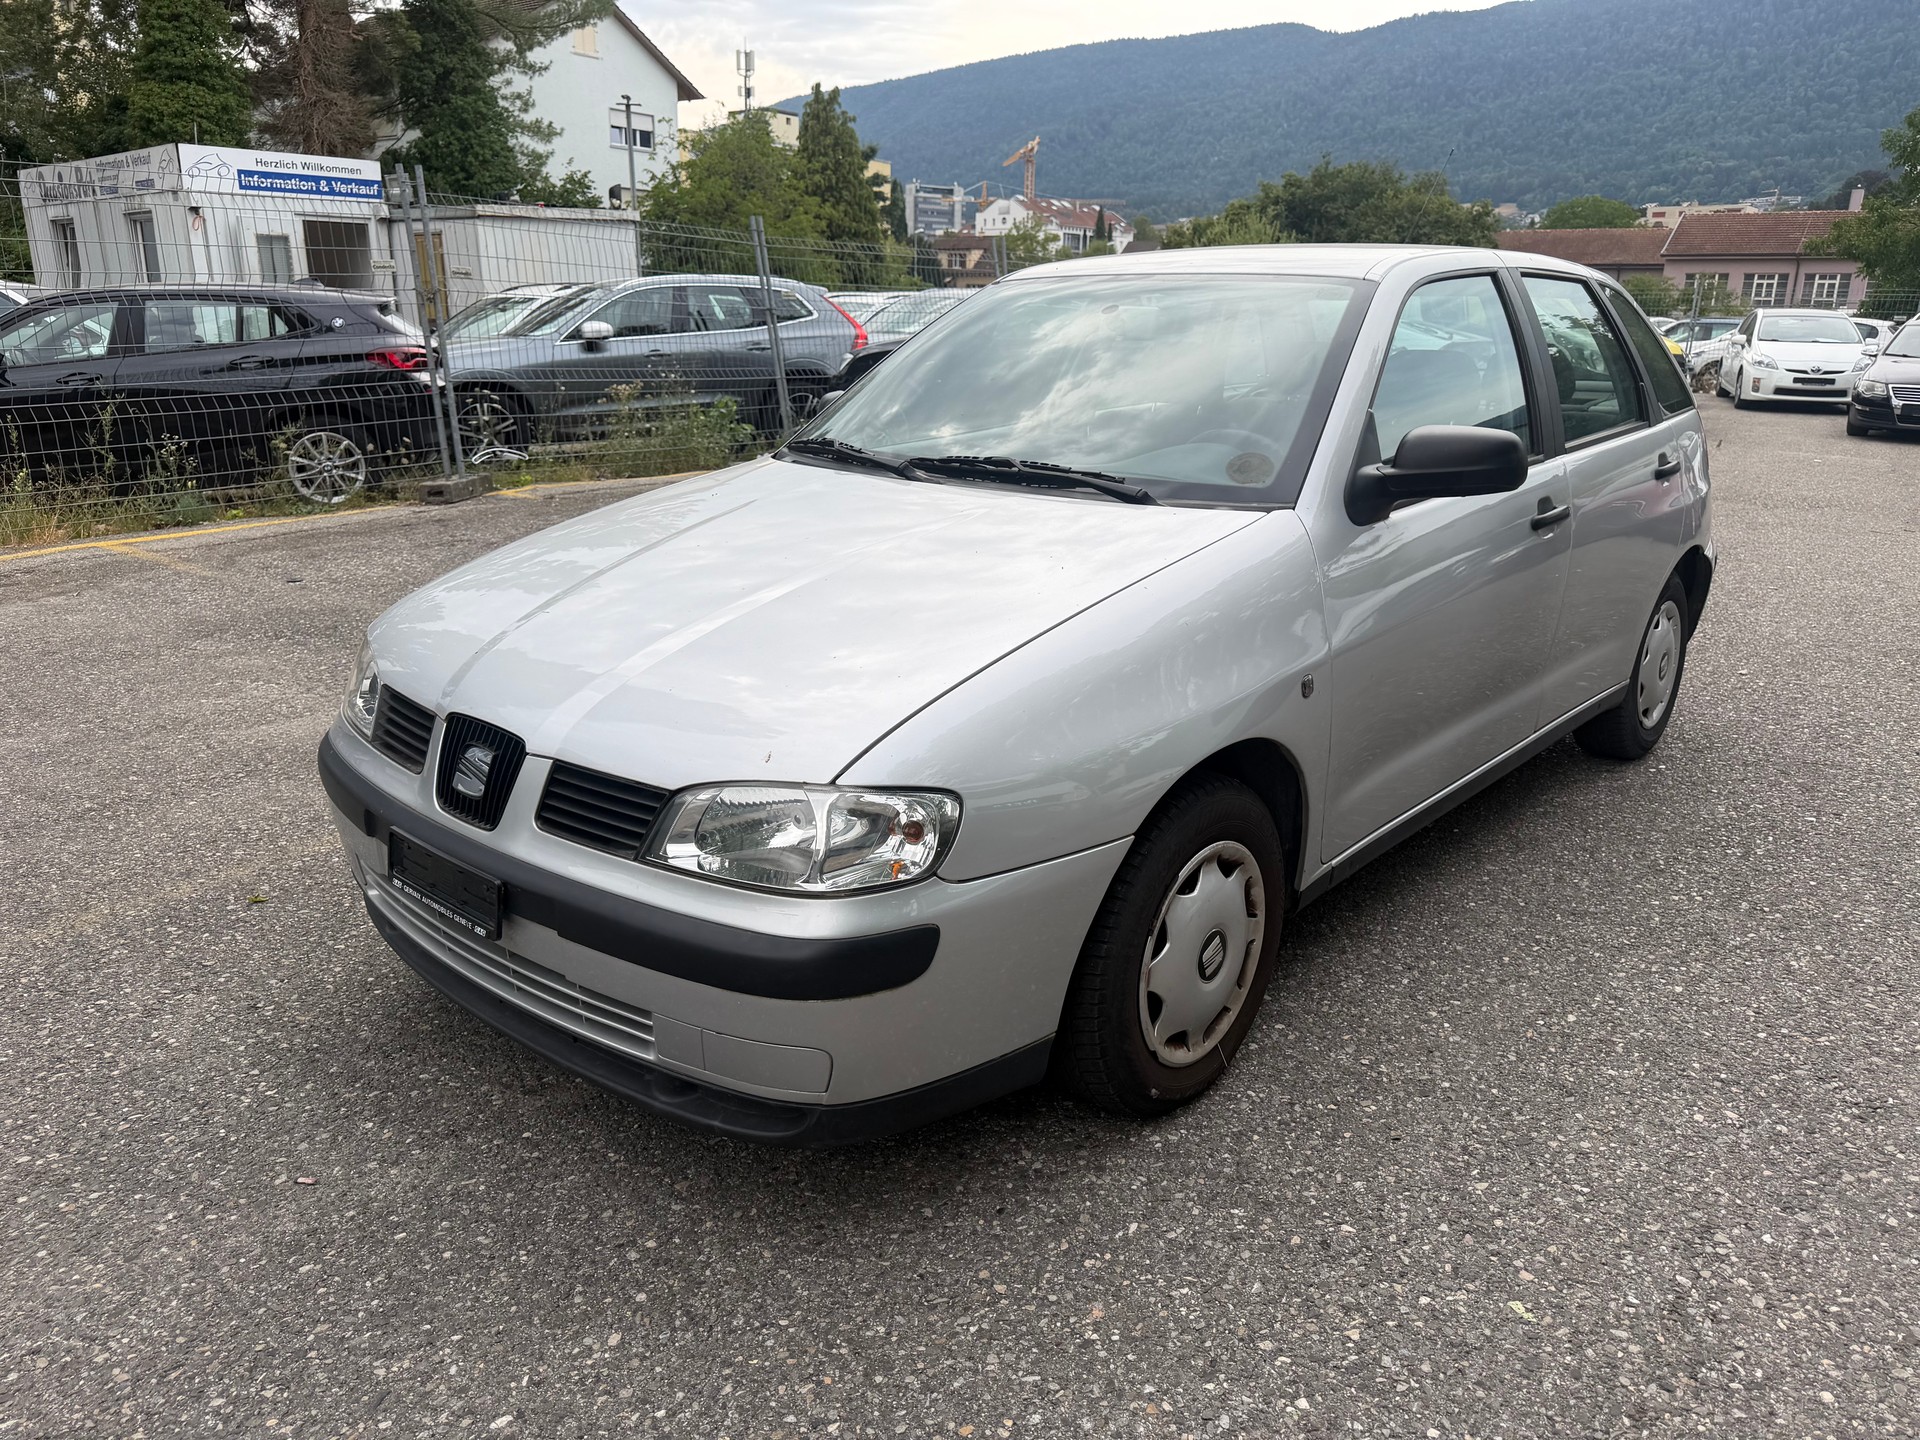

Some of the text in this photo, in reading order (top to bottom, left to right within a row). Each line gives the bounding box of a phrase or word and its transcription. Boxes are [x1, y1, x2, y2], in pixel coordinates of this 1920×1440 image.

[130, 152, 151, 167] Verkauf
[255, 158, 362, 175] Herzlich Willkommen
[241, 174, 379, 195] Information & Verkauf
[403, 885, 421, 900] GERVAIX
[422, 896, 453, 918] AUTOMOBILES
